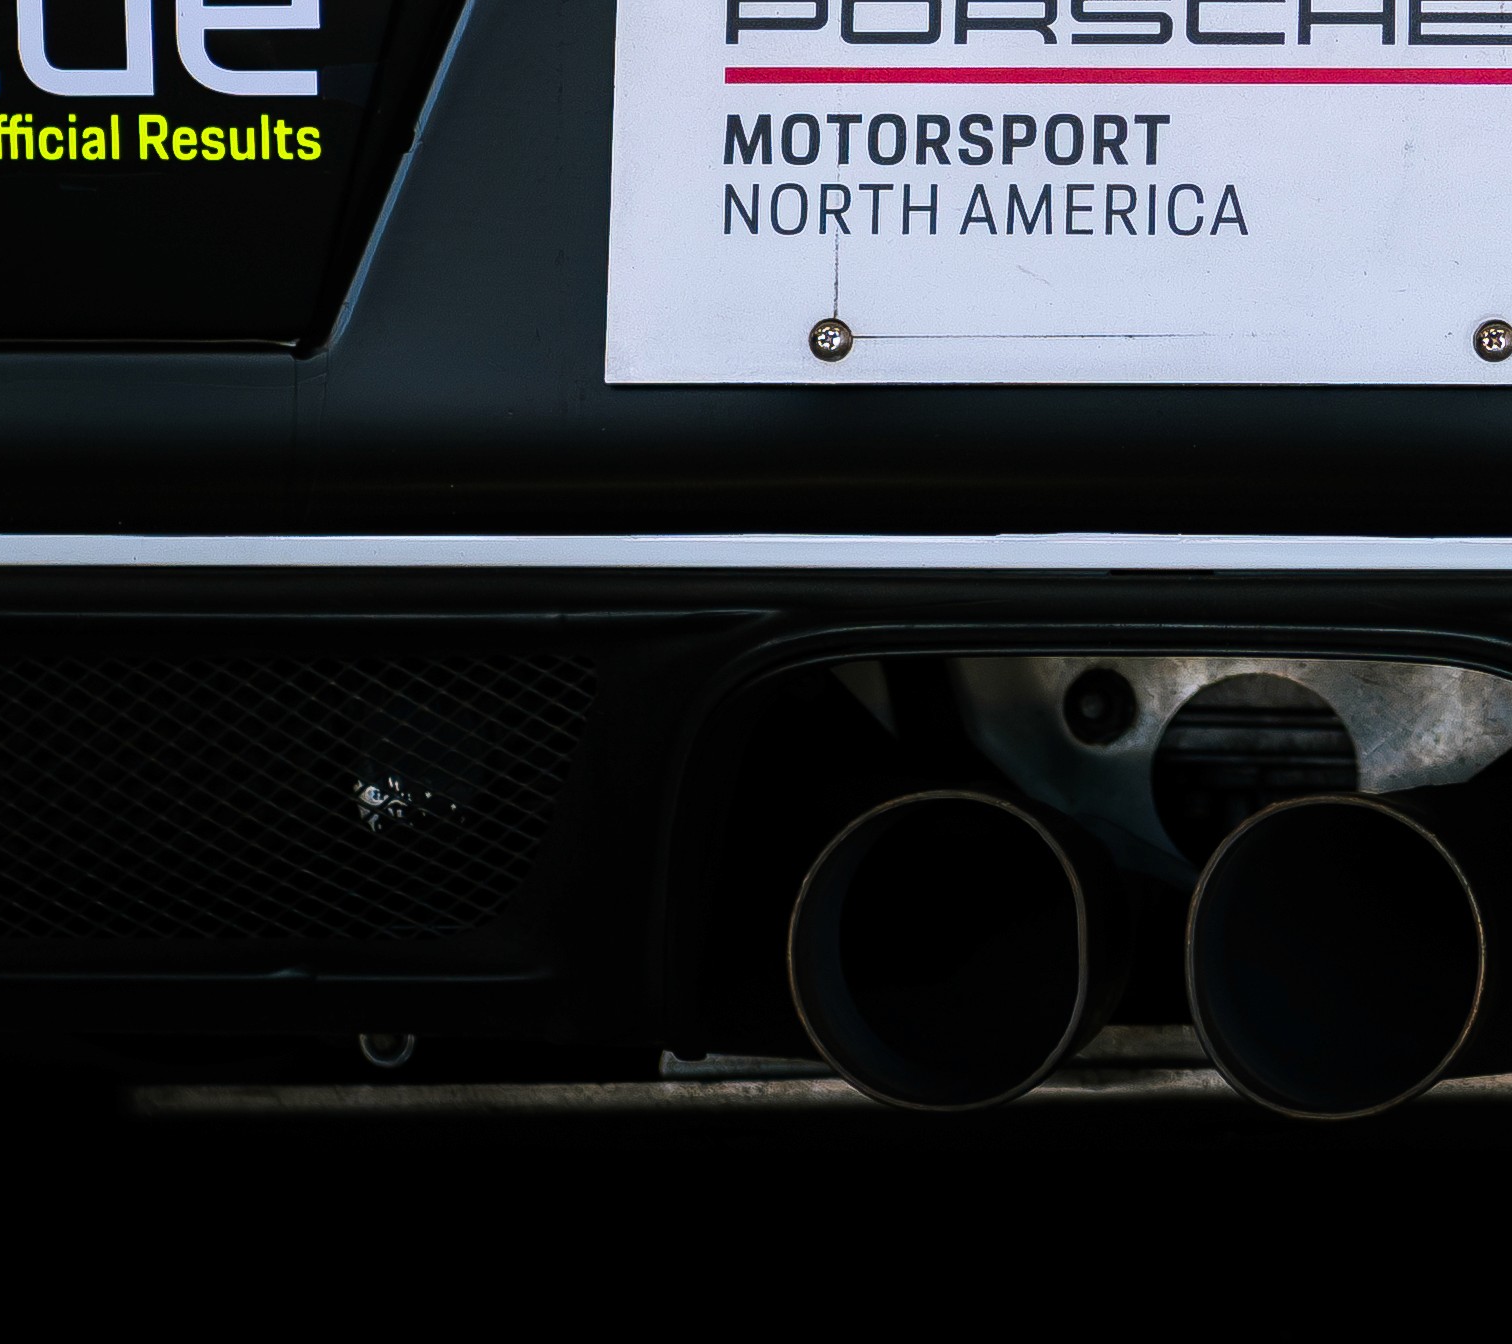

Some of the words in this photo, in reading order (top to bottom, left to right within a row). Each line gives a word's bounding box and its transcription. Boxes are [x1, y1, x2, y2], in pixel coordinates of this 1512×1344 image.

[139, 114, 322, 161] Results
[723, 114, 1171, 166] MOTORSPORT
[723, 184, 938, 236] NORTH
[960, 184, 1248, 236] AMERICA
